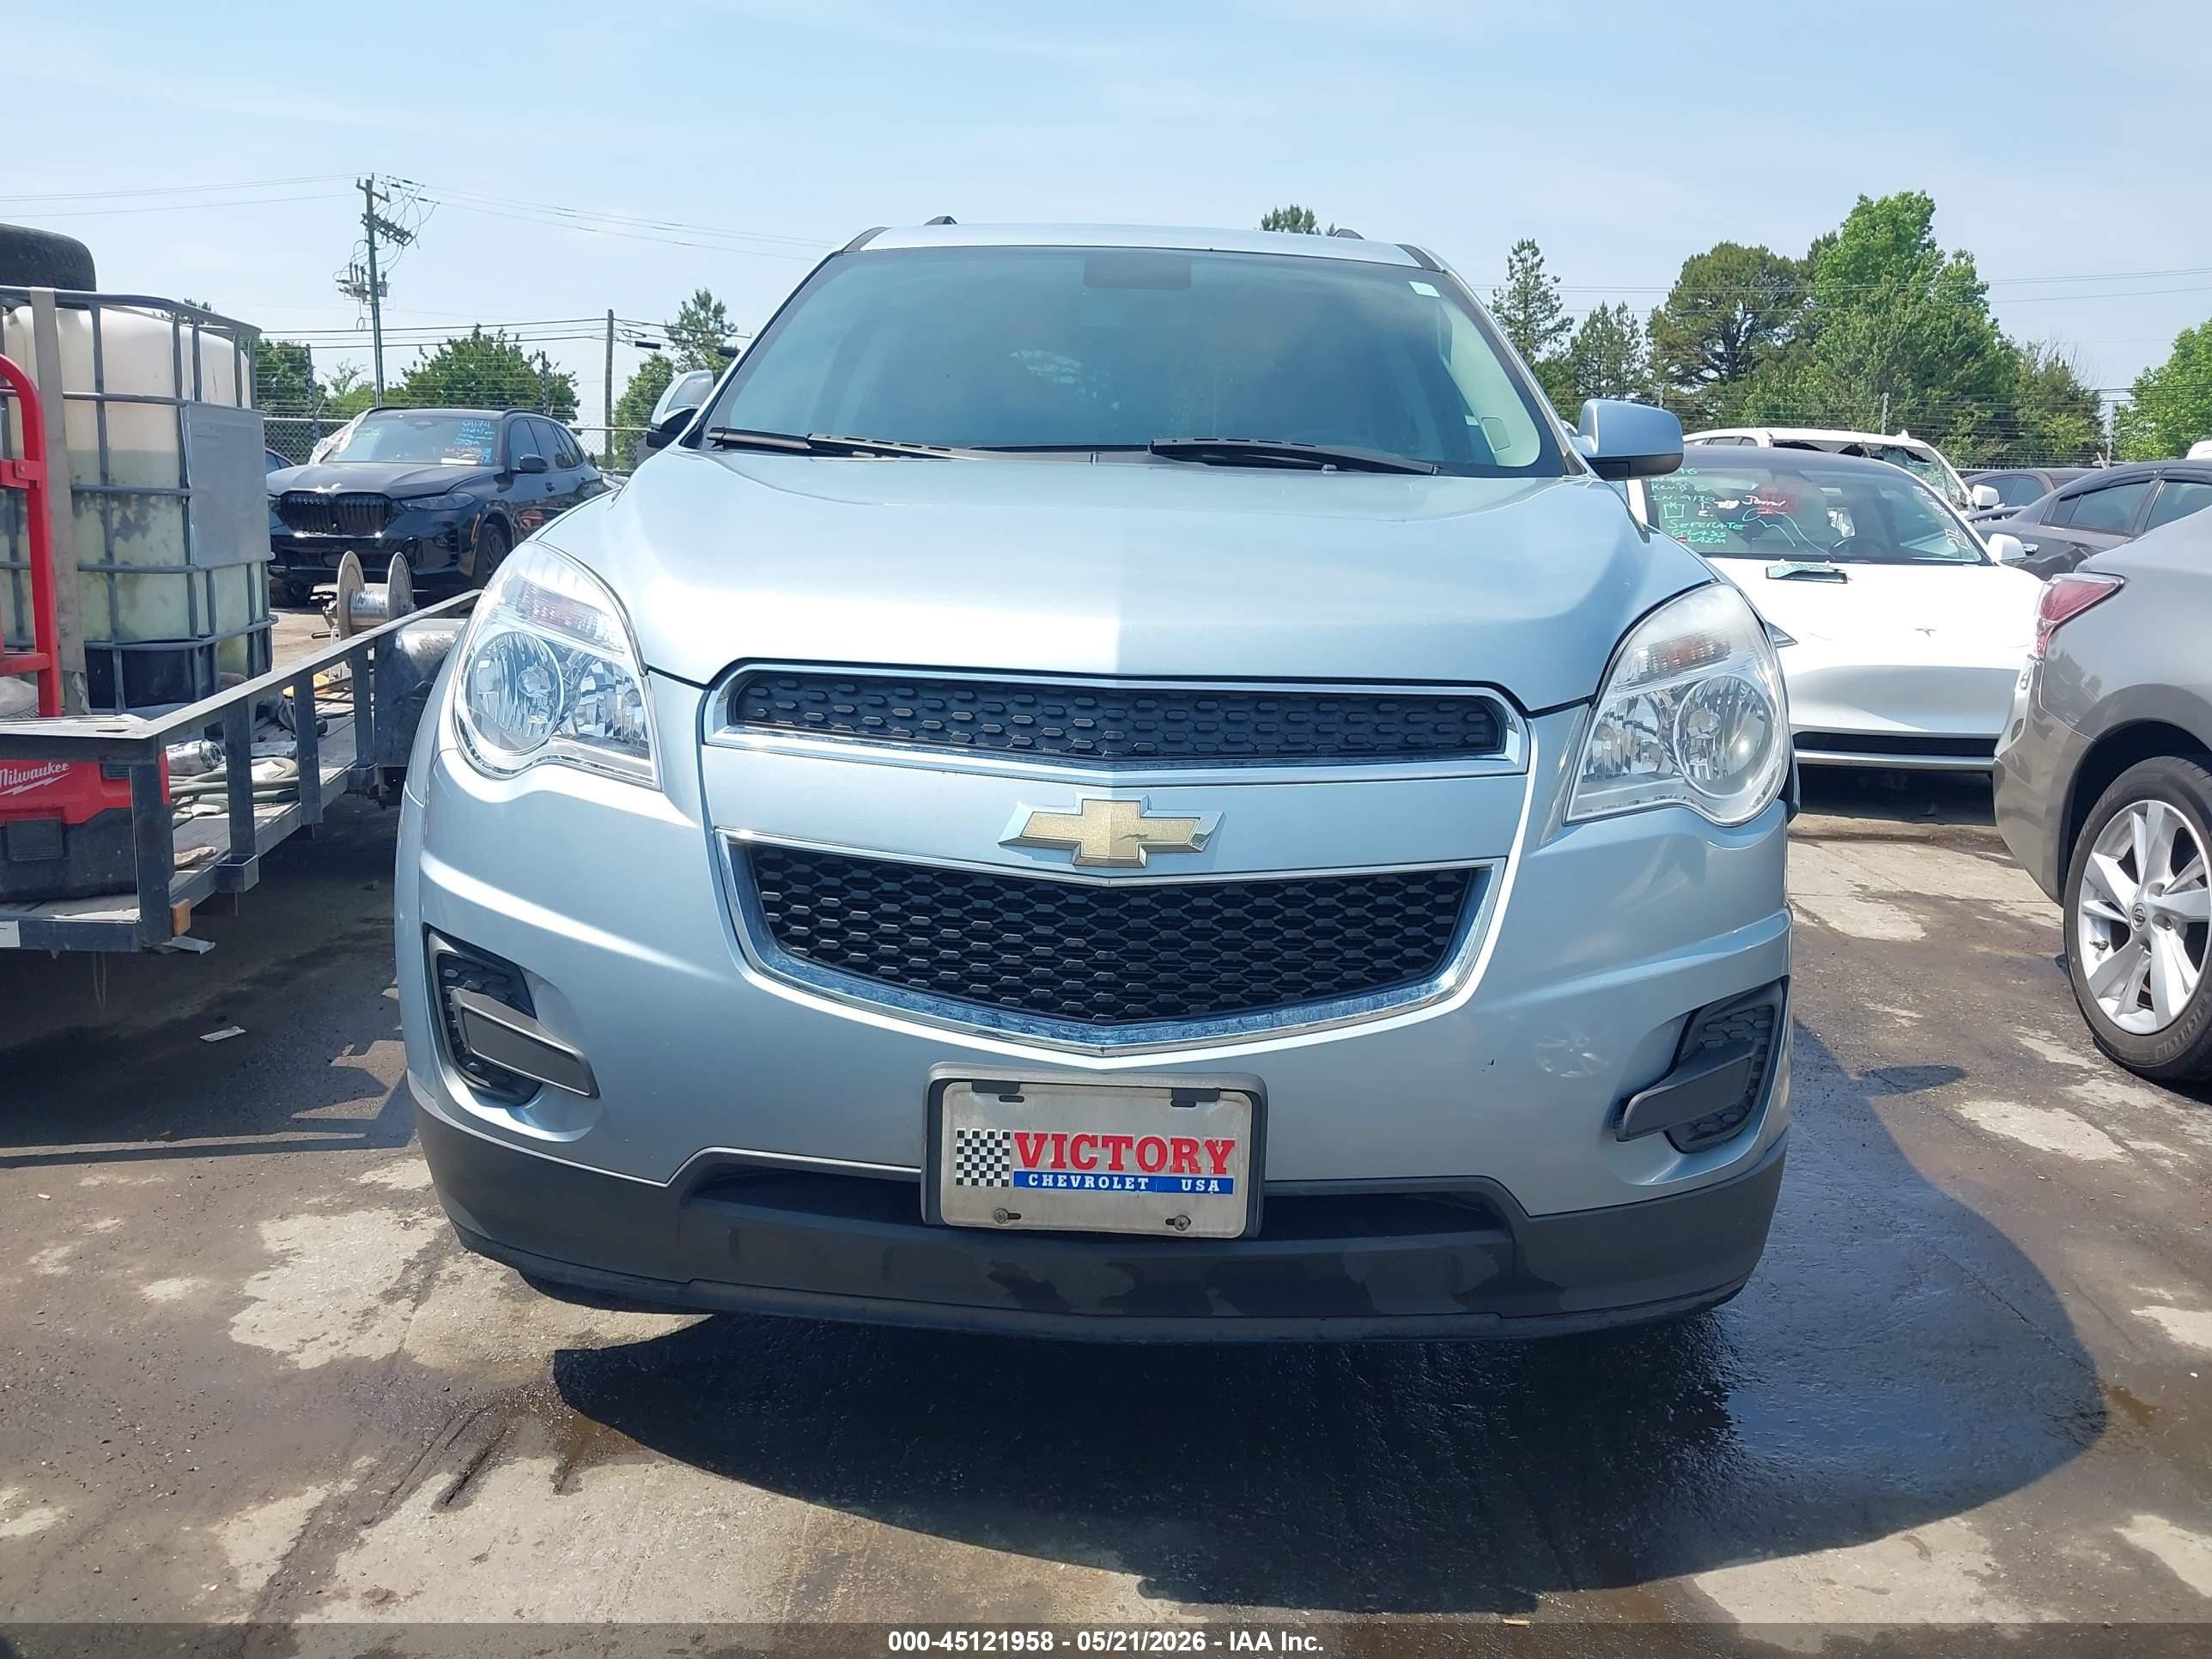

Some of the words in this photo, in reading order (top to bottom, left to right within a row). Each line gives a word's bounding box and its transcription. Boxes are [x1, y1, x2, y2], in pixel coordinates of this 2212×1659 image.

[0, 762, 70, 788] Milwaukee
[1013, 1131, 1236, 1175] VICTORY
[1028, 1173, 1150, 1190] CHEVROLET
[1181, 1178, 1220, 1193] USA
